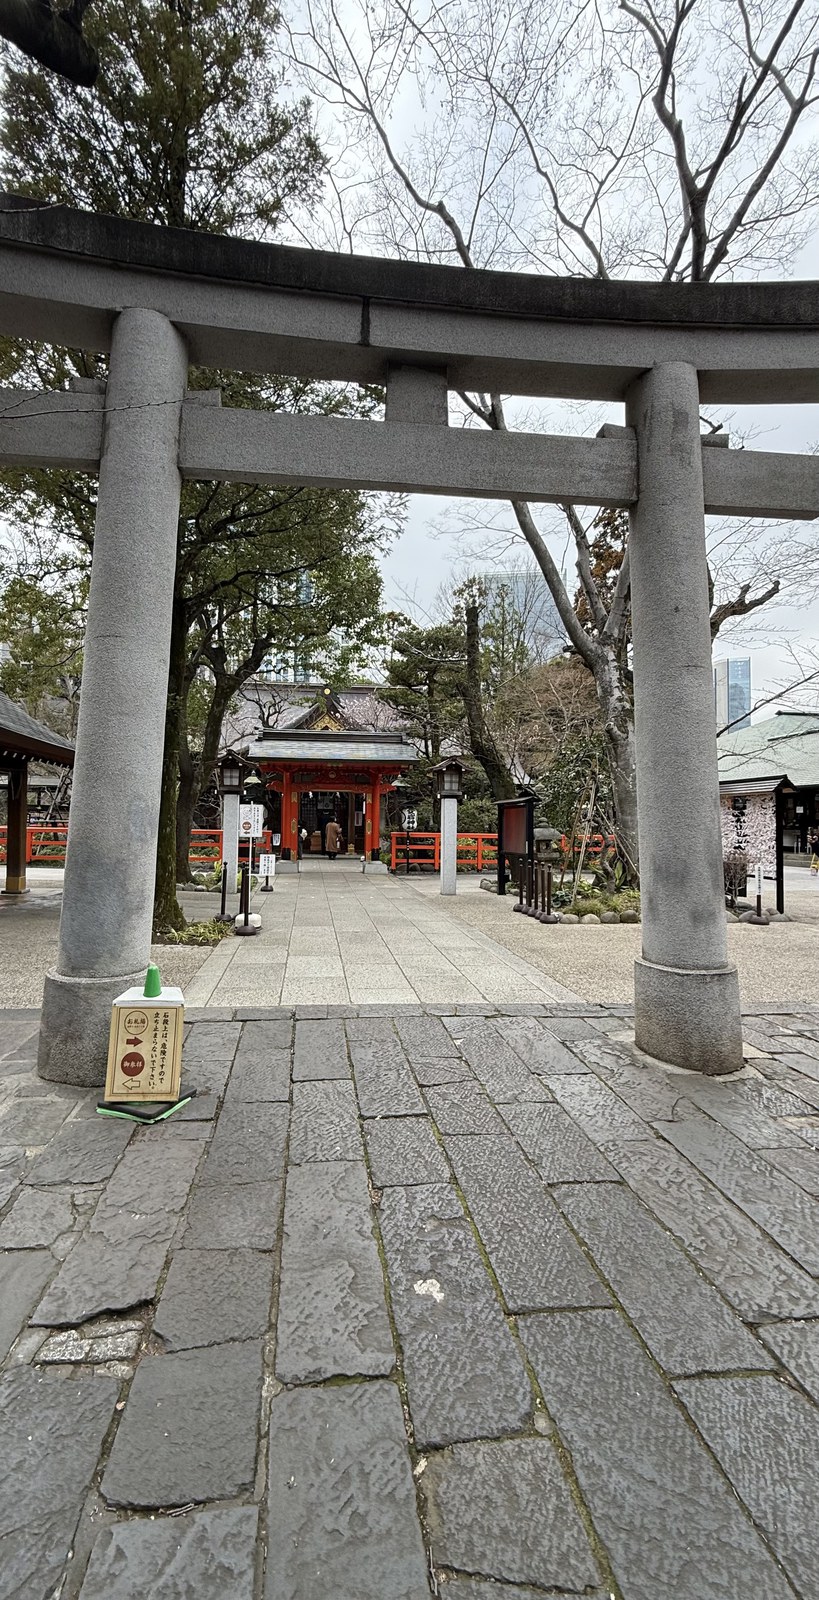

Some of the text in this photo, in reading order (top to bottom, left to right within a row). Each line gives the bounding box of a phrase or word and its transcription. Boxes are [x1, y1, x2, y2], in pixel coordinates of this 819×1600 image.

[148, 1012, 160, 1089] 立ち止まらないで下さい。
[159, 1012, 169, 1083] 石段上は、危険ですので
